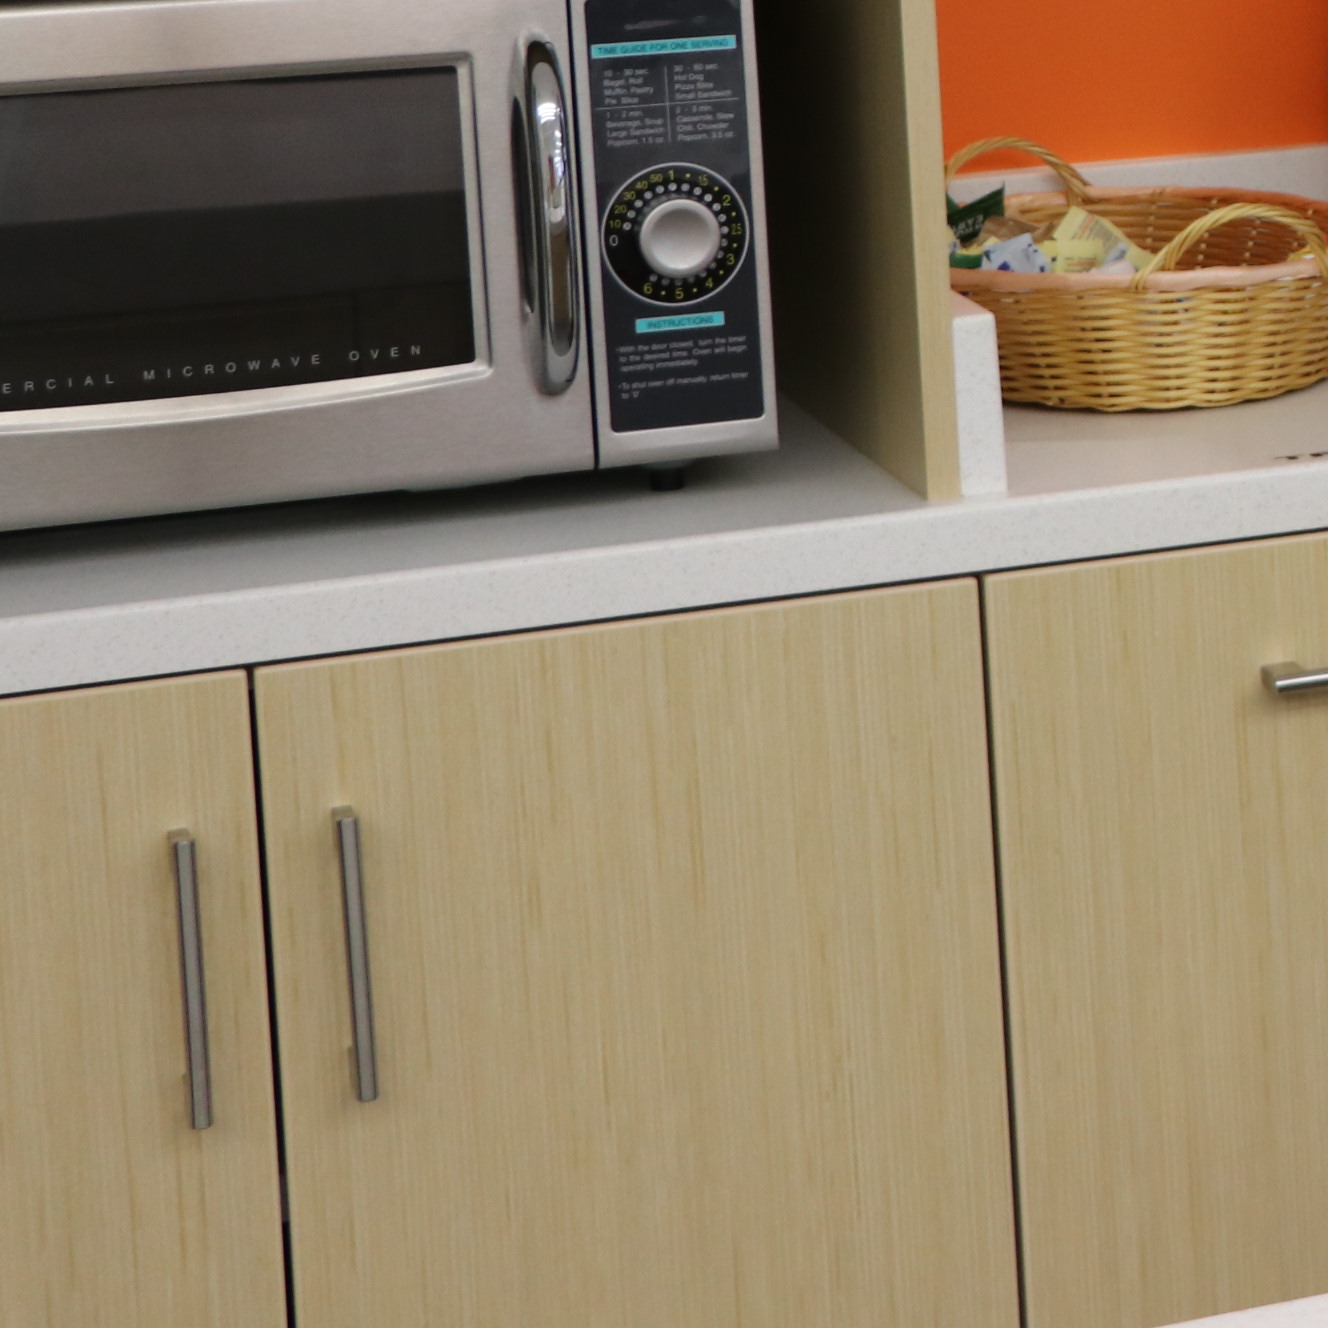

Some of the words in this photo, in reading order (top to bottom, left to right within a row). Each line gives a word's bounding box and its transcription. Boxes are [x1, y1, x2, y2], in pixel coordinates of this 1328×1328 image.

[598, 46, 616, 54] TIME
[621, 44, 647, 53] GUIDE
[650, 43, 667, 51] FOR
[670, 42, 687, 50] ONE
[690, 39, 728, 49] SERVING
[650, 174, 663, 183] 50
[668, 170, 674, 180] 1
[635, 181, 648, 190] 40
[624, 191, 636, 200] 30
[723, 195, 731, 206] 2
[614, 204, 627, 214] 20
[609, 220, 621, 229] 10
[609, 235, 619, 246] 0
[726, 254, 735, 265] 3
[705, 278, 714, 288] 4
[643, 283, 652, 294] 6
[675, 289, 684, 299] 5
[143, 354, 321, 381] MICROWAVE
[348, 345, 422, 362] OVEN
